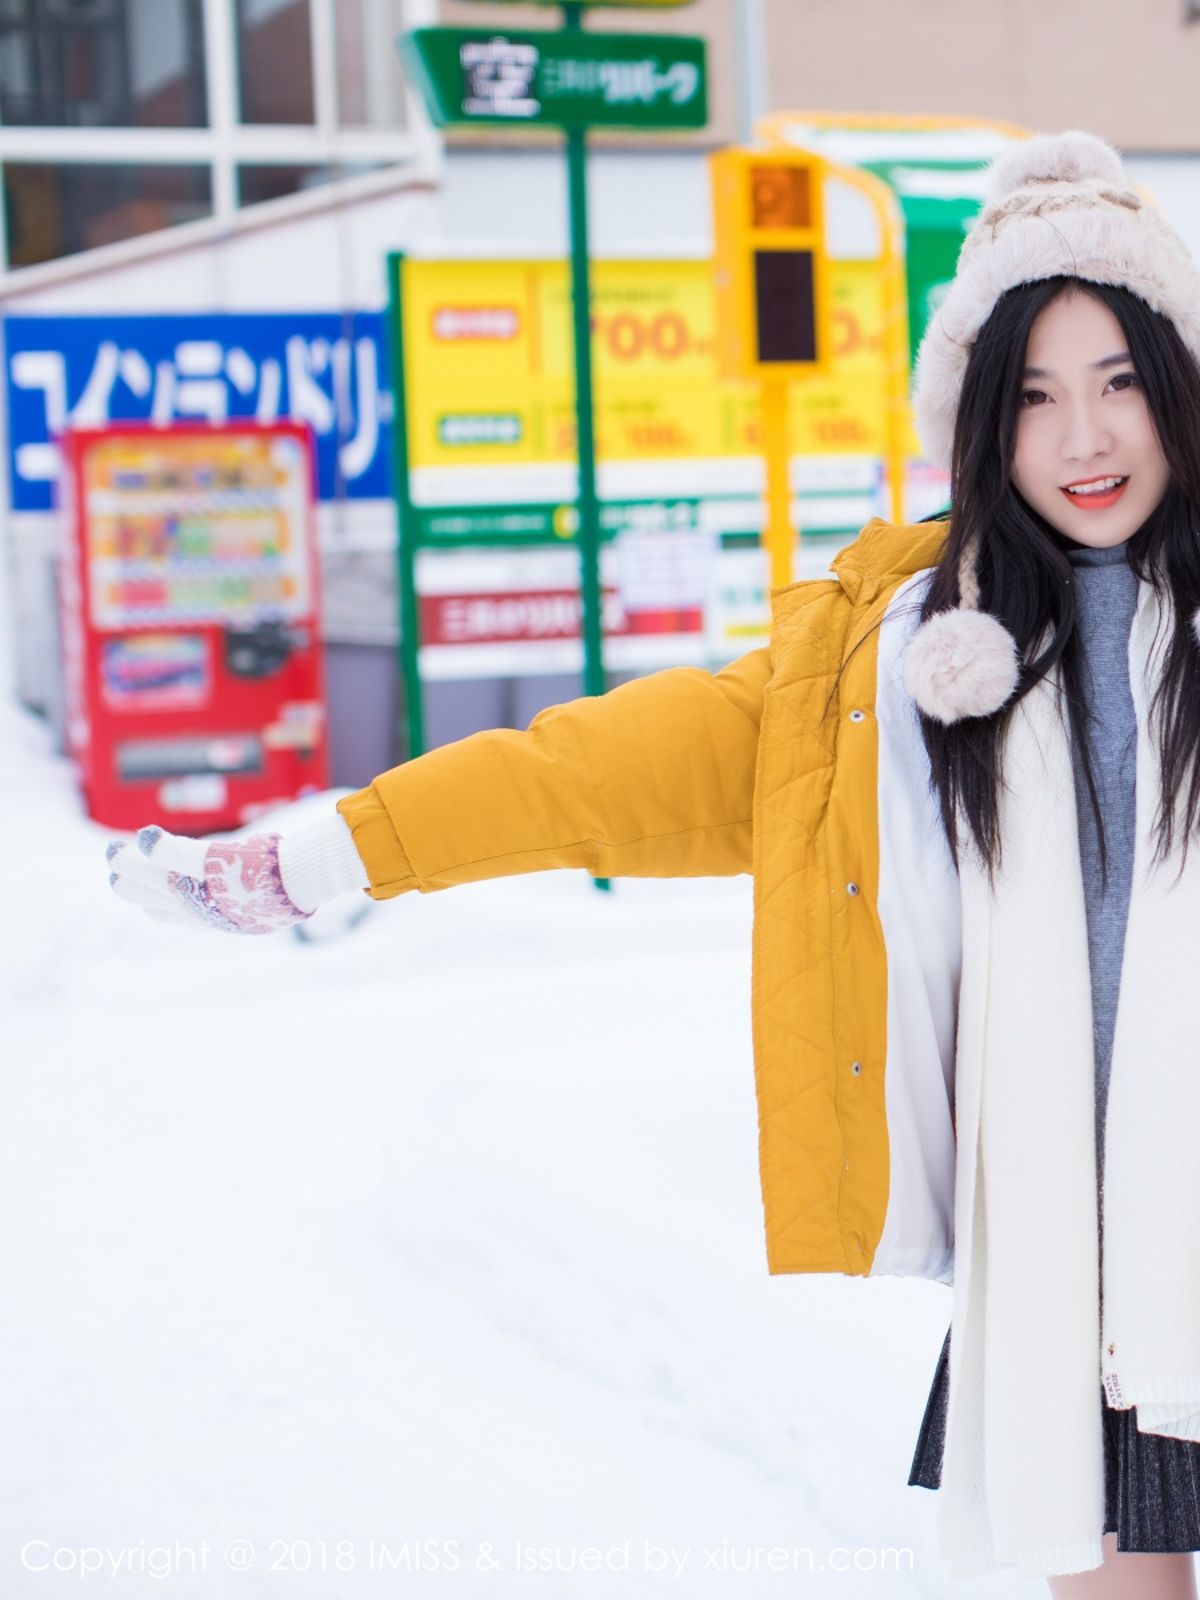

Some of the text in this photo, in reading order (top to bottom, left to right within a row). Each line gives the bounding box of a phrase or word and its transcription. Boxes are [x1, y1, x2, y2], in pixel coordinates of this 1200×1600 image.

[11, 334, 395, 480] コインランドリ
